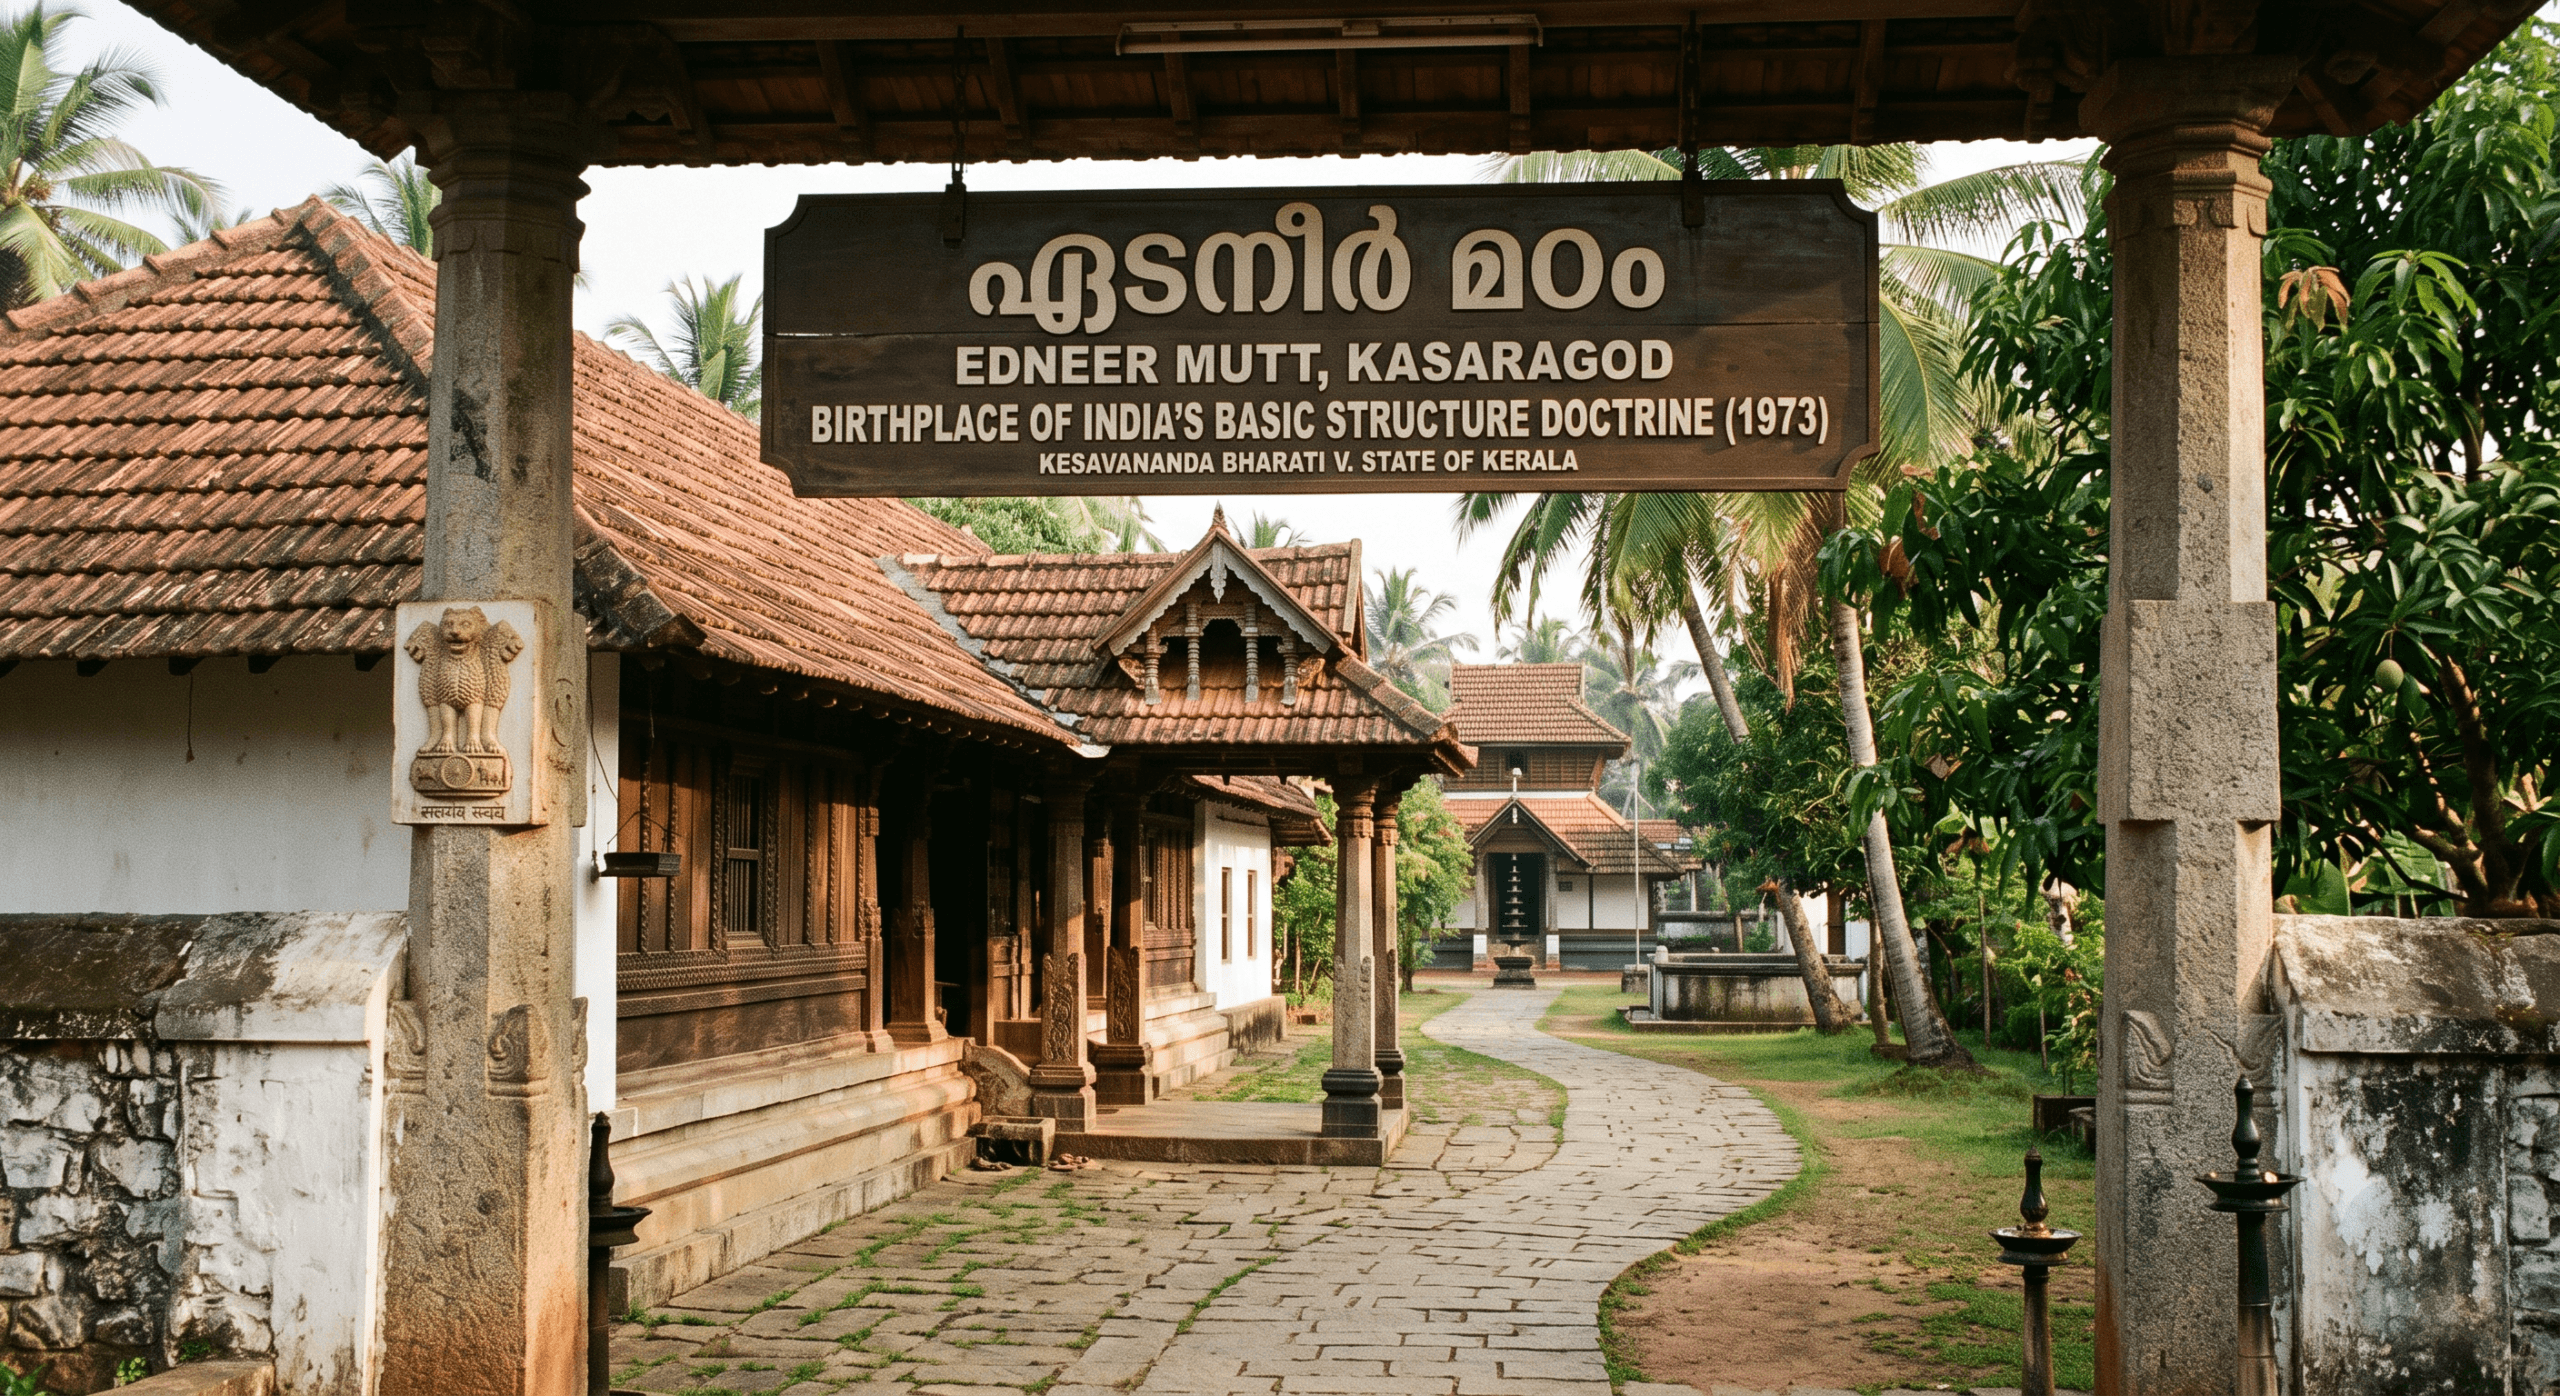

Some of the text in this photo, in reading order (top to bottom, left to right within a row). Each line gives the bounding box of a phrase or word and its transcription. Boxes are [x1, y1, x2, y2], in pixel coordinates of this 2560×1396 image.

[968, 201, 1666, 335] ഏടനീർ മഠം
[956, 339, 1675, 393] EDNEER MUTT, KASARAGOD
[811, 395, 1830, 446] BIRTHPLACE OF INDIA’S BASIC STRUCTURE DOCTRINE (1973)
[1038, 449, 1579, 475] KESAVANANDA BHARATI V. STATE OF KERALA
